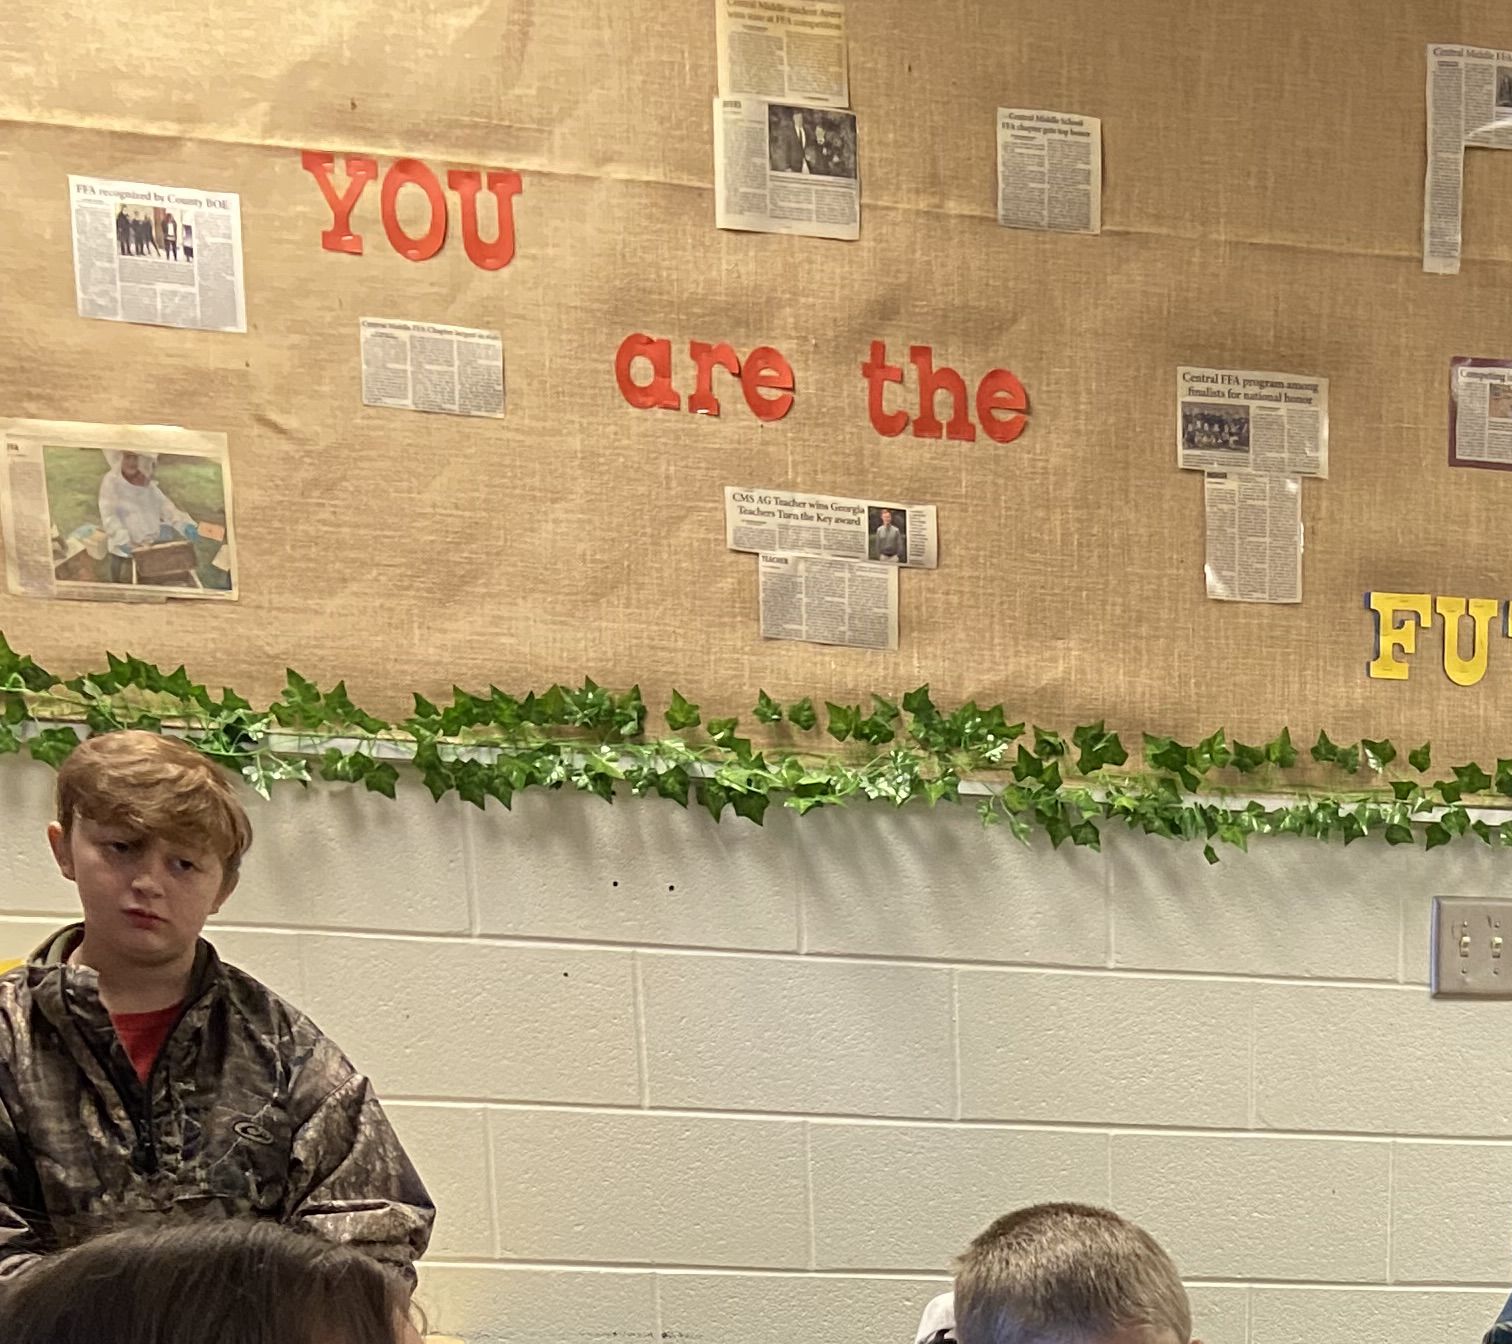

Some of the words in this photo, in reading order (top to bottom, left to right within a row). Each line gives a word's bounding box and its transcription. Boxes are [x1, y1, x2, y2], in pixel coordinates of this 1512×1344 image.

[1433, 46, 1463, 57] Central
[1496, 51, 1512, 62] FFA
[76, 183, 96, 195] FFA
[99, 188, 151, 201] recognized
[154, 192, 165, 203] by
[167, 195, 203, 208] County
[301, 150, 522, 271] YOU
[615, 332, 795, 421] are
[861, 340, 1029, 444] the
[1182, 371, 1219, 384] Central
[1220, 374, 1240, 386] FFA
[1242, 378, 1283, 390] program
[1285, 381, 1319, 393] among
[1188, 386, 1226, 398] finalists
[1227, 389, 1242, 399] for
[1243, 391, 1282, 403] national
[1283, 393, 1313, 404] honor
[732, 492, 755, 503] CMS
[756, 495, 772, 505] AG
[773, 496, 807, 509] Teacher
[808, 501, 829, 511] wins
[830, 502, 866, 516] Georgia
[738, 505, 776, 518] Teachers
[777, 509, 799, 521] Turn
[800, 511, 815, 522] the
[816, 512, 834, 525] Key
[834, 515, 861, 526] award
[761, 554, 789, 565] TEACHER
